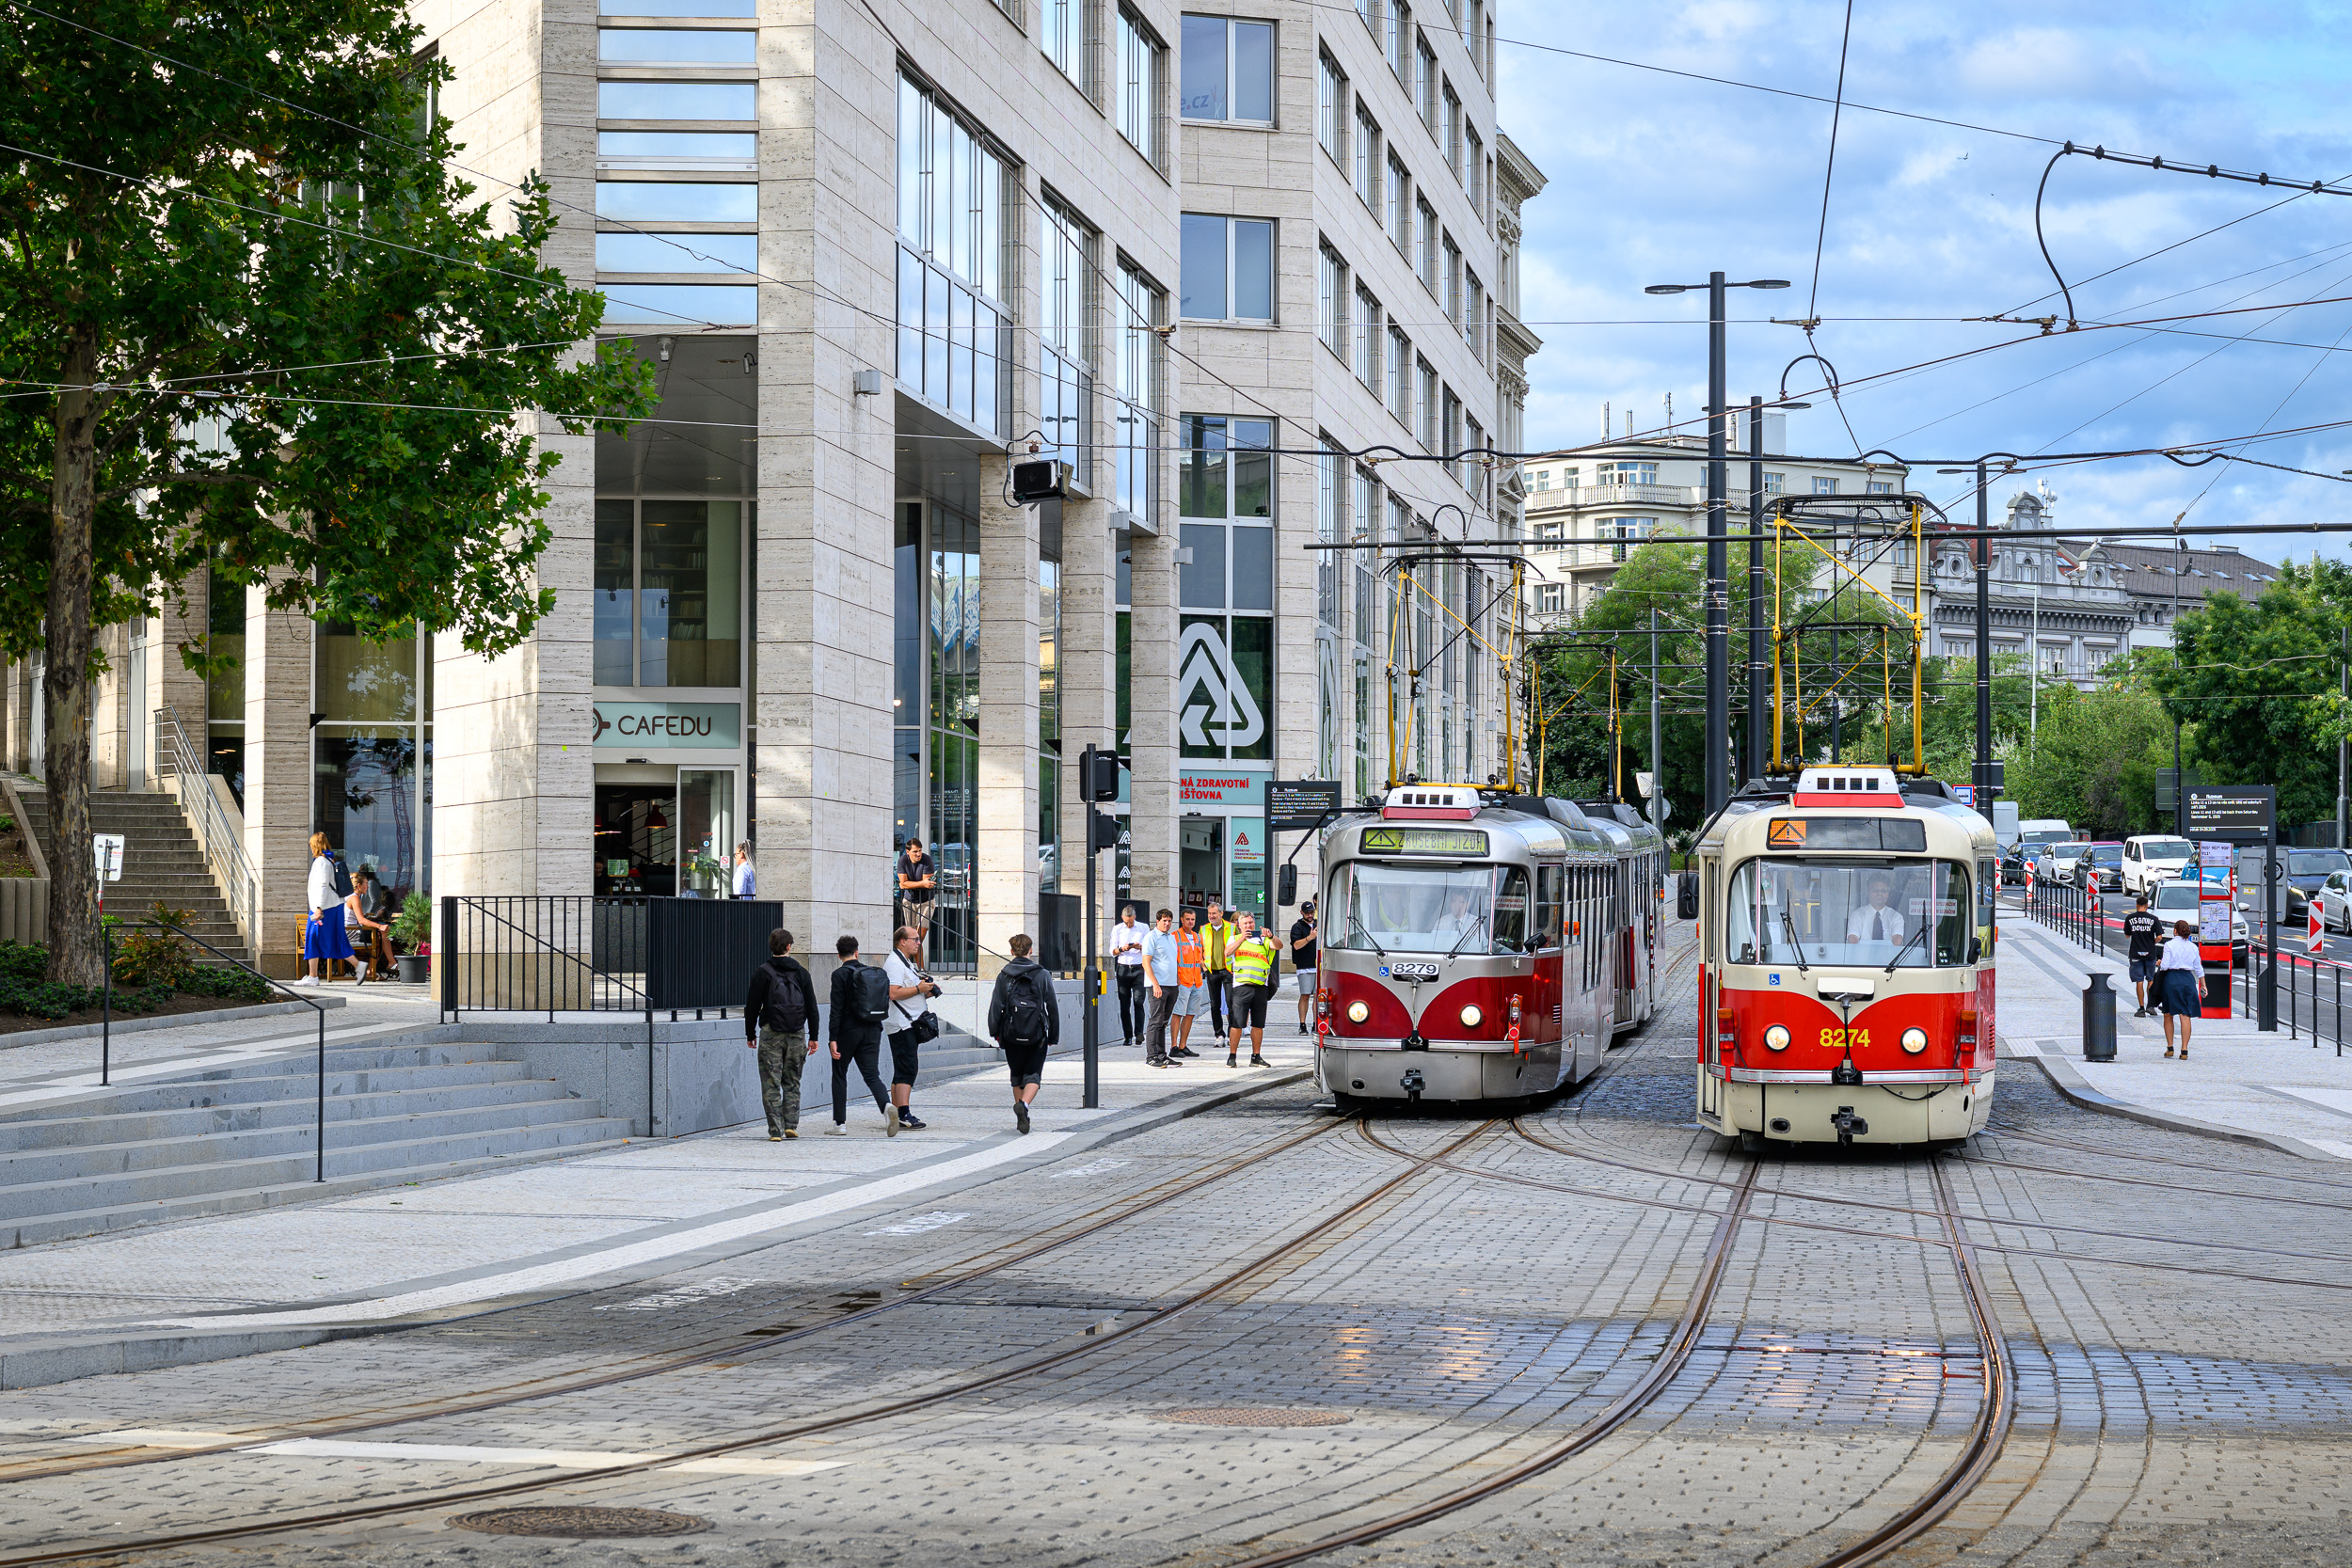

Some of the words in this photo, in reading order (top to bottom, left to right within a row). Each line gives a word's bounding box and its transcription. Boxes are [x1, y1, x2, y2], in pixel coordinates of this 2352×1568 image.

[617, 715, 711, 736] CAFEDU
[1179, 776, 1194, 787] NÁ
[1196, 777, 1250, 789] ZDRAVOTNÍ
[1179, 787, 1223, 800] IŠŤOVNA
[1393, 963, 1438, 974] 8279
[1819, 1027, 1871, 1048] 8274
